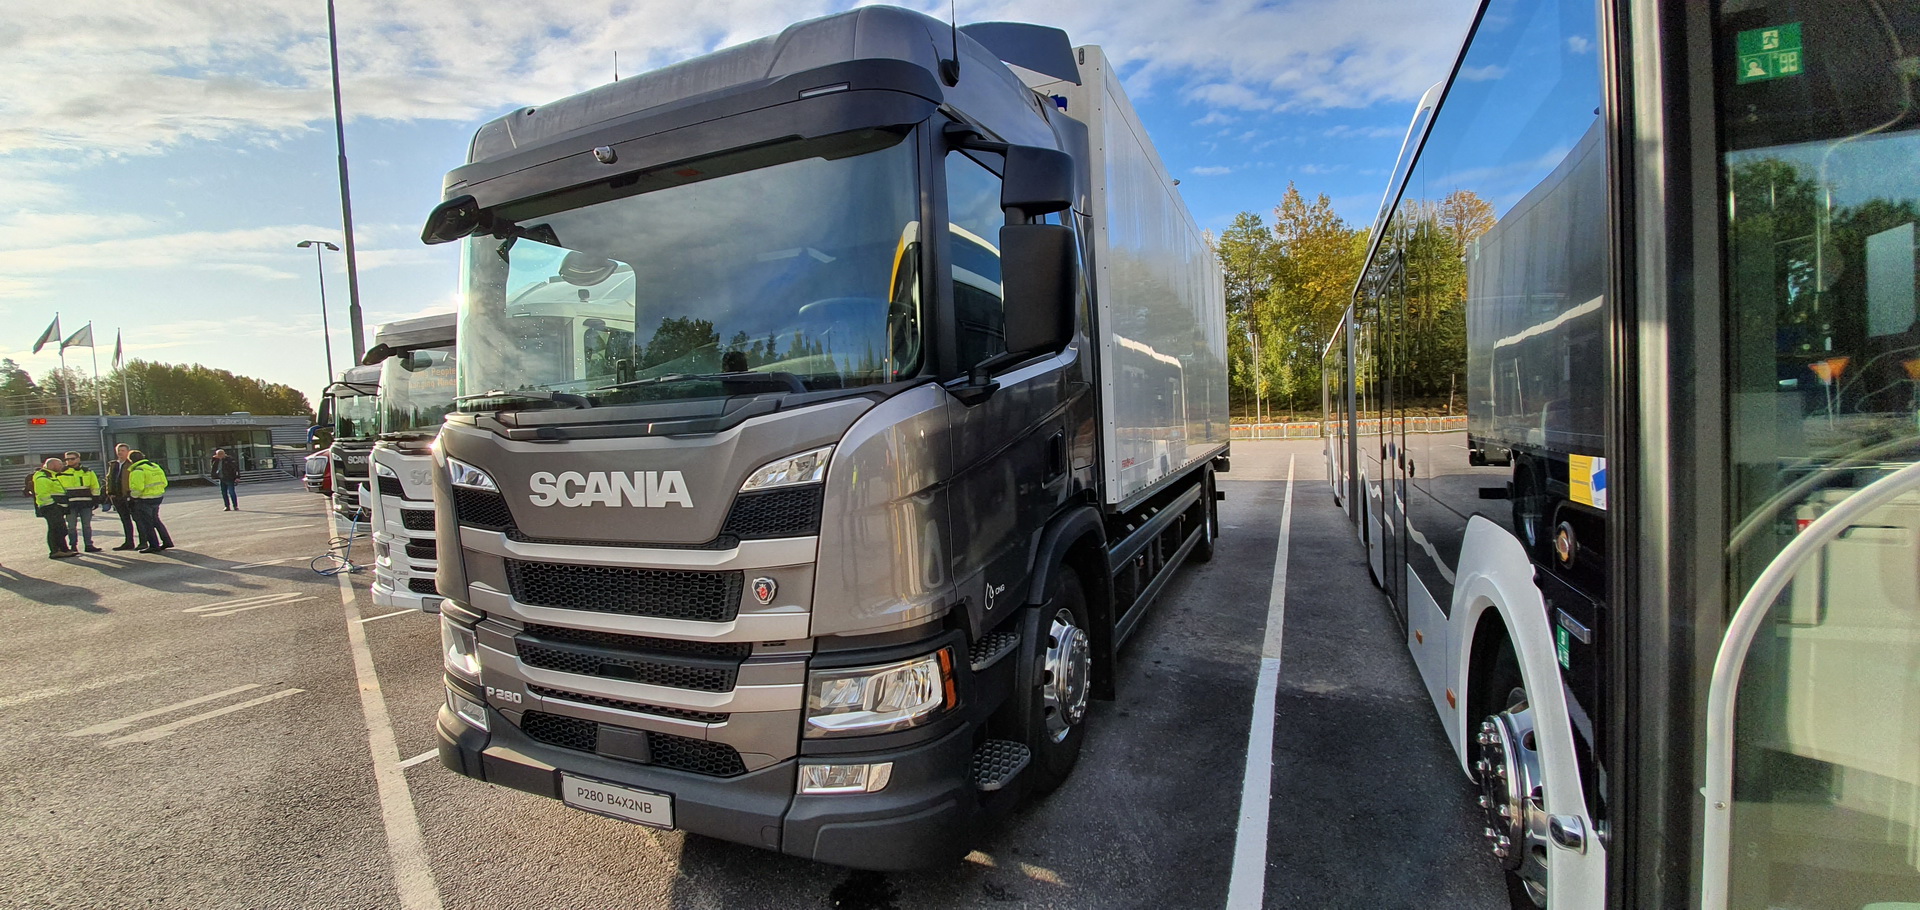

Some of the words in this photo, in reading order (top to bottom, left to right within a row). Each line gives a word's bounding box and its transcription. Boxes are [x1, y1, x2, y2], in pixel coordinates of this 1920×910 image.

[529, 471, 694, 508] SCANIA
[486, 686, 495, 697] P
[495, 688, 522, 704] 280
[577, 787, 604, 803] P280
[606, 793, 652, 814] B4X2NB
